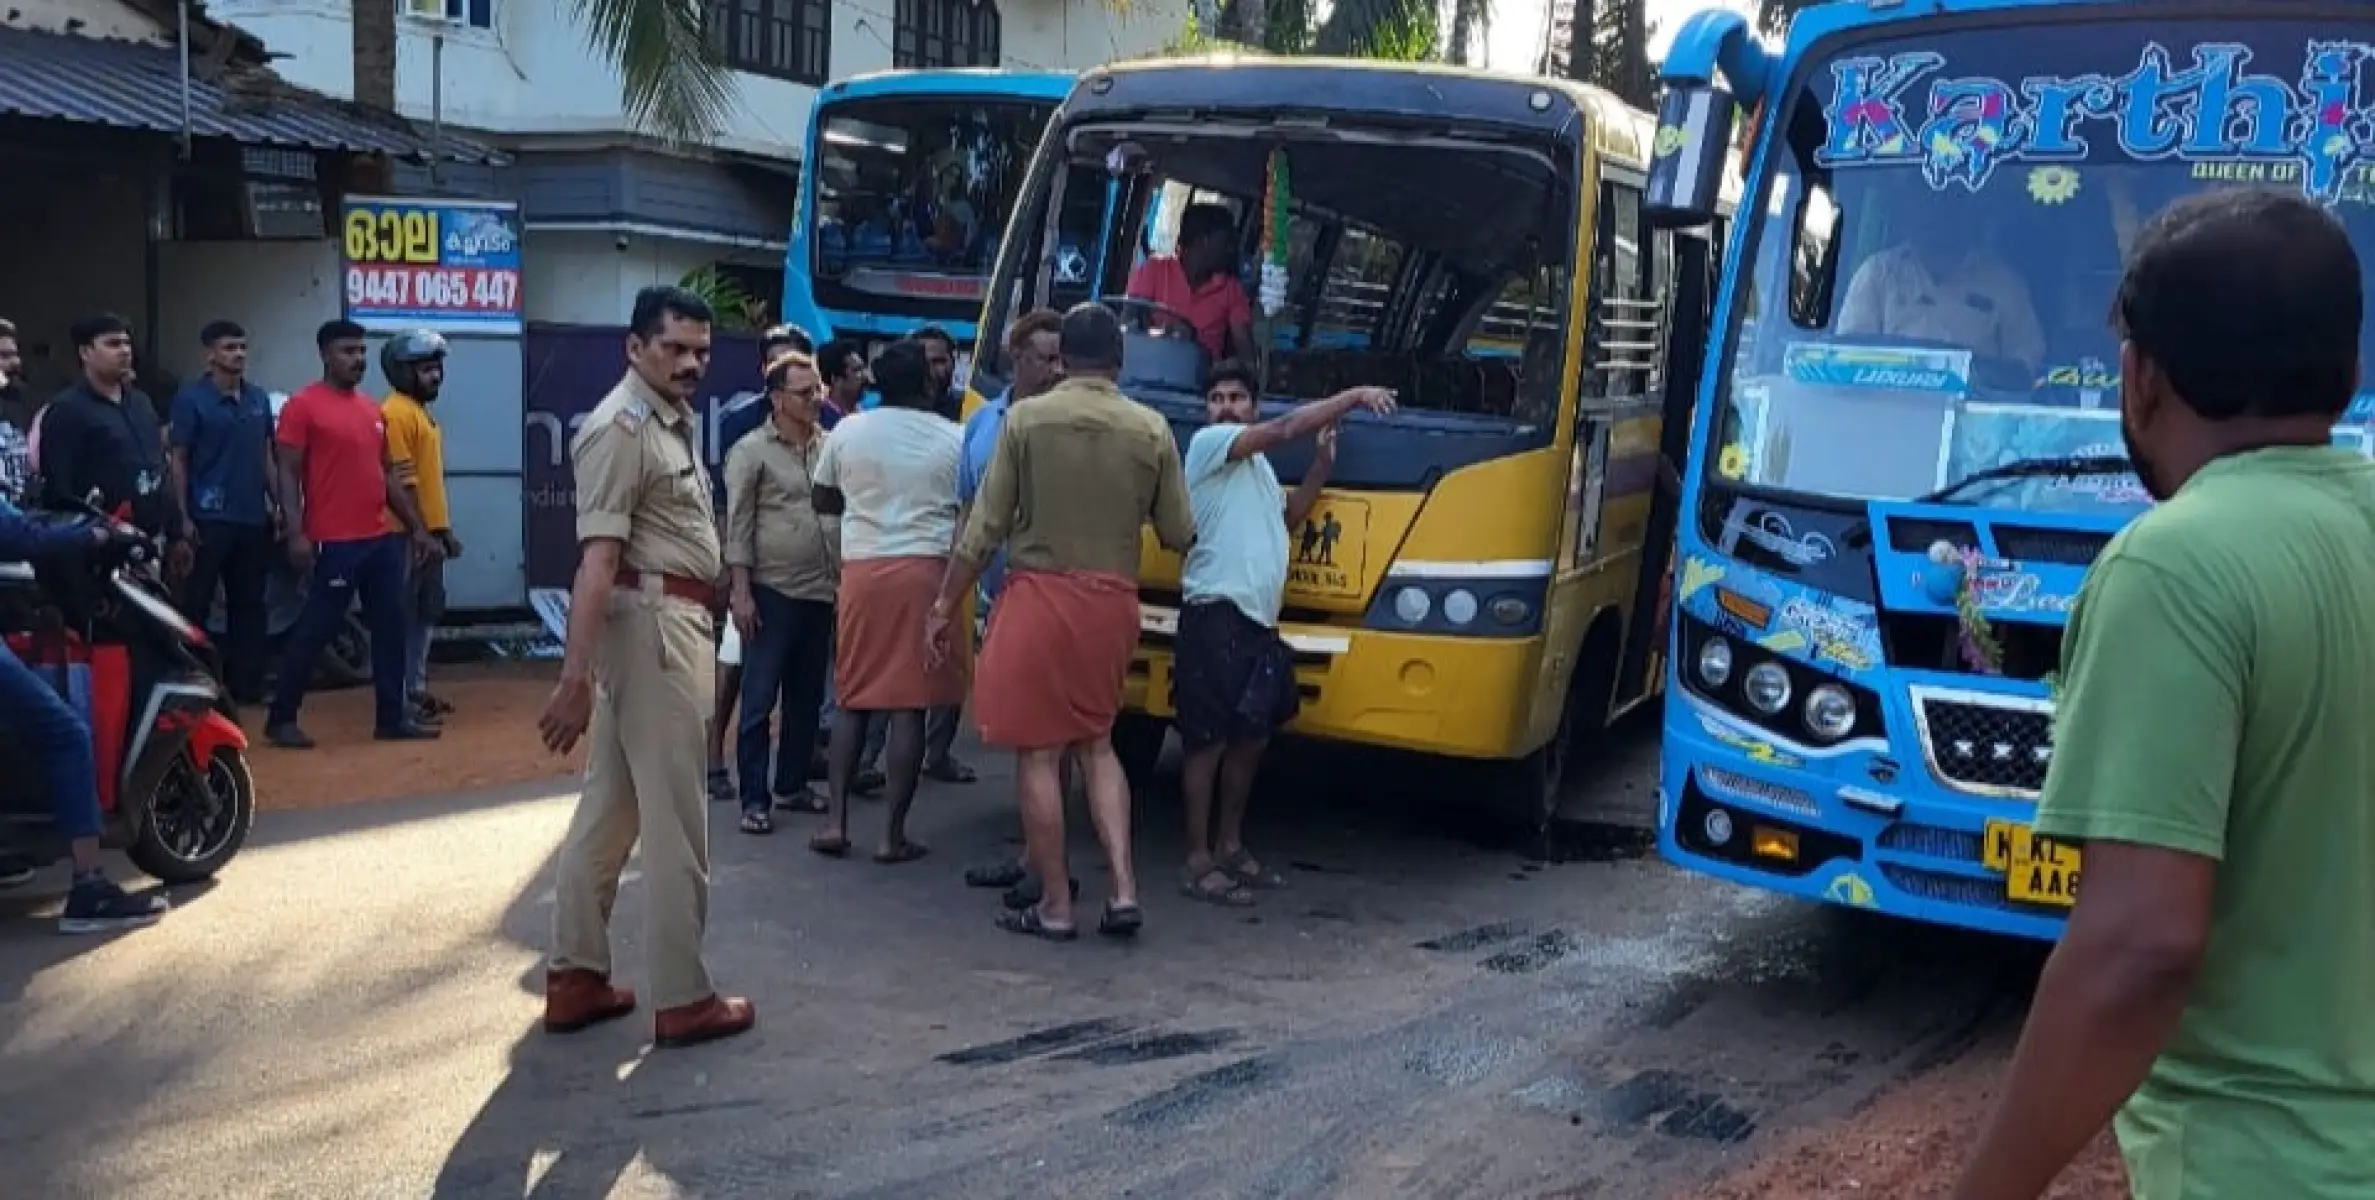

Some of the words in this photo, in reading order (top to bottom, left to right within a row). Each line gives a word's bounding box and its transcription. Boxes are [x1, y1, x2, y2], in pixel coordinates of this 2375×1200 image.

[1813, 38, 2375, 200] Karthi
[2191, 162, 2264, 180] QUEEN
[346, 209, 438, 262] ഓല
[348, 269, 409, 303] 9447
[415, 271, 468, 307] 065
[473, 271, 518, 310] 447
